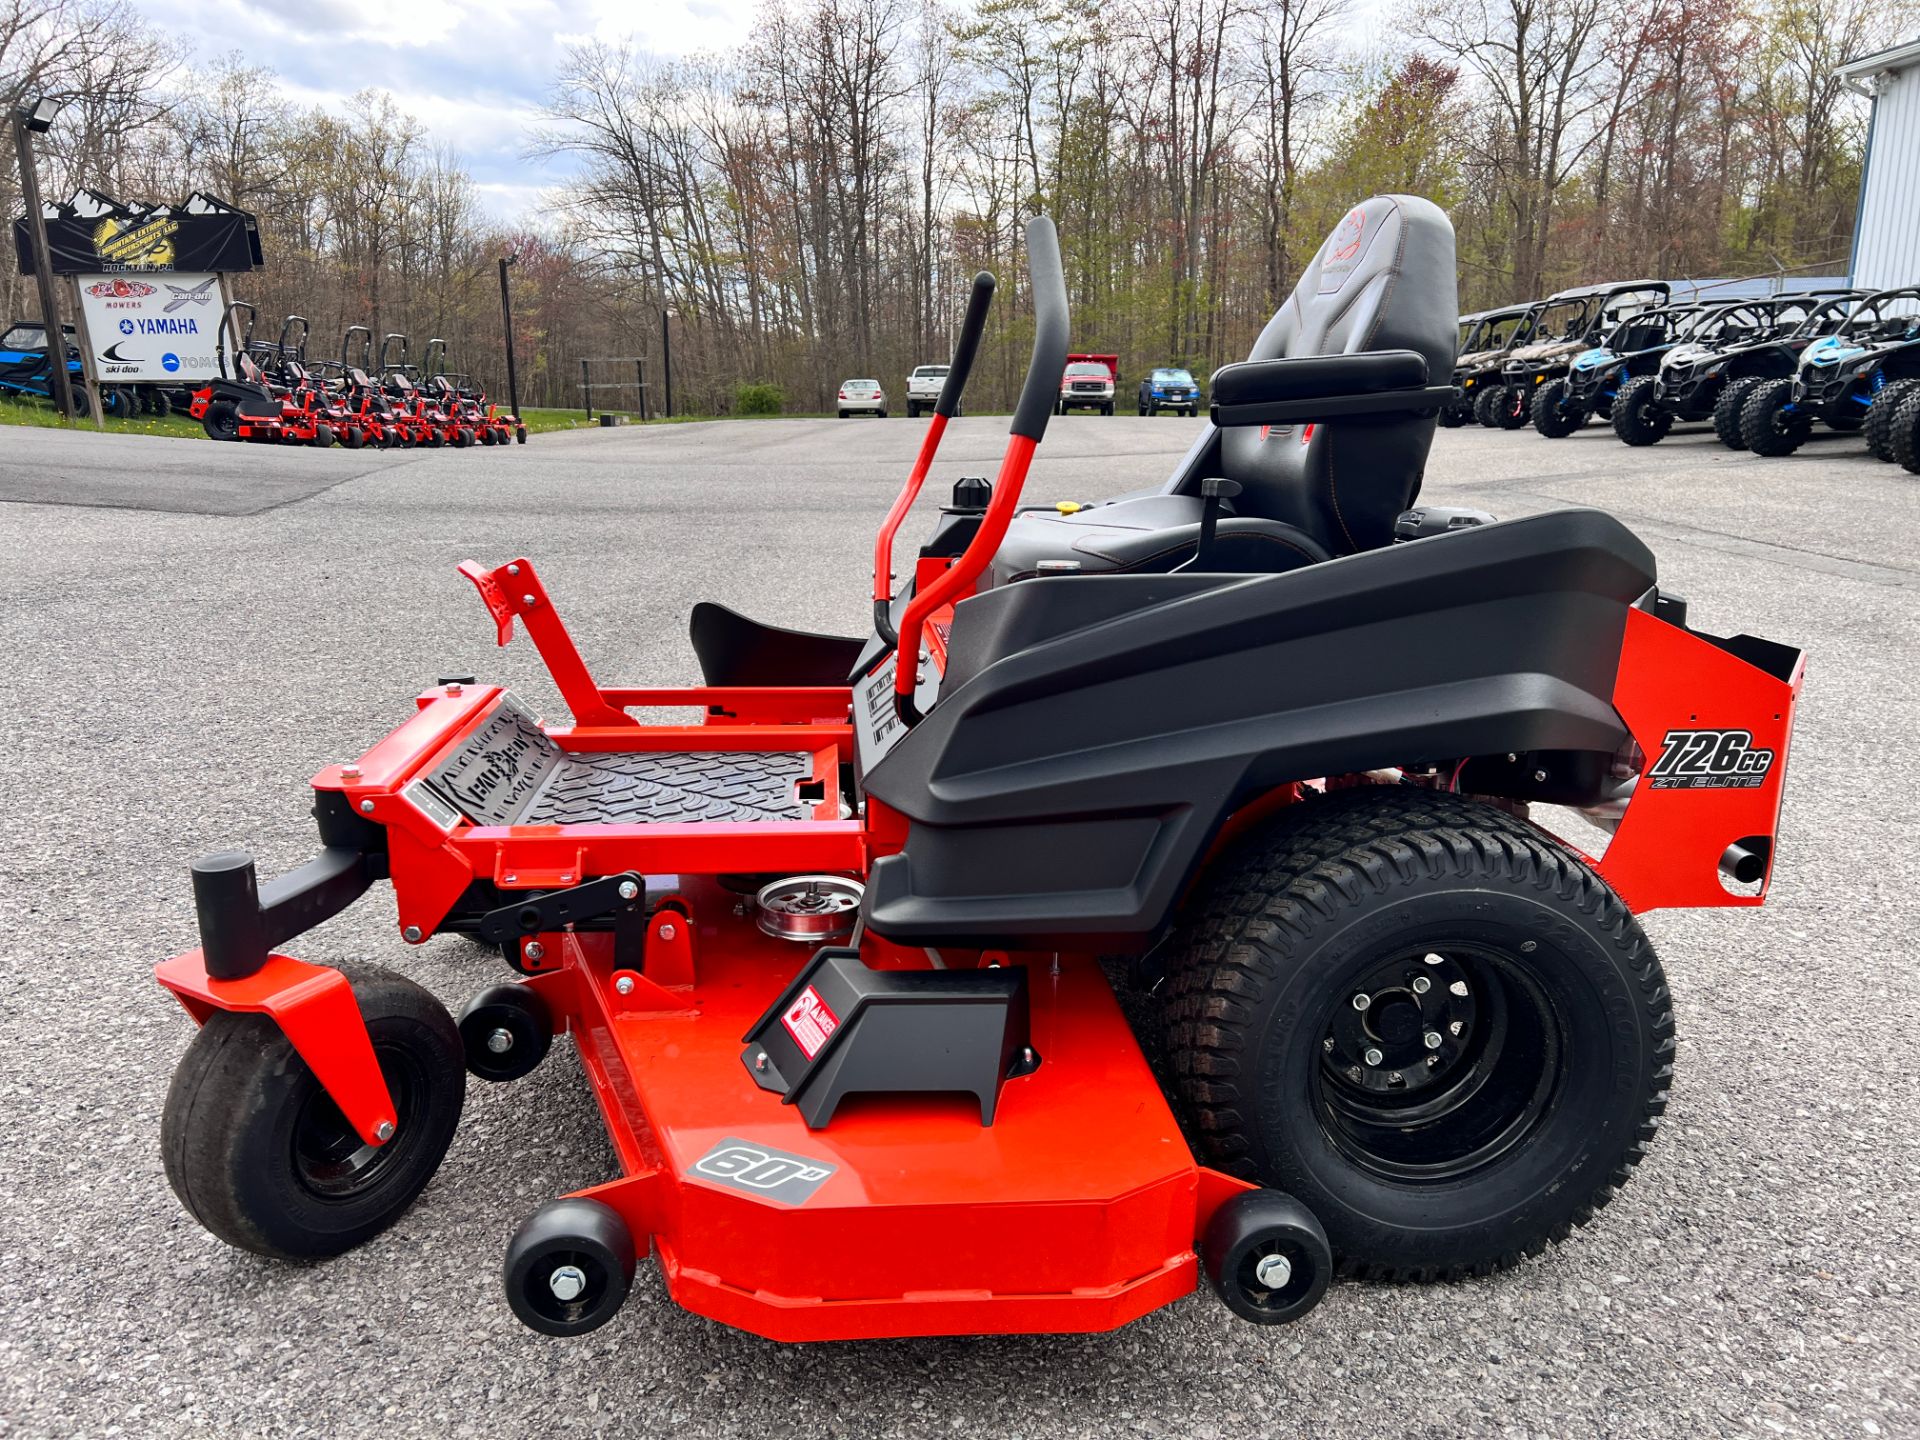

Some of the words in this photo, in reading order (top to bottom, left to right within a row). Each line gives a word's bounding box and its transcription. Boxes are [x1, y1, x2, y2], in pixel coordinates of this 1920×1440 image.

[101, 231, 137, 257] MOUNTAIN
[137, 216, 169, 237] EXTREME
[112, 229, 162, 261] POWERSPORTS
[163, 221, 178, 235] LLC
[159, 263, 175, 271] PA
[136, 318, 199, 335] YAMAHA
[1649, 731, 1774, 776] 726cc
[1651, 776, 1688, 789] ZT
[1690, 776, 1764, 788] ELITE
